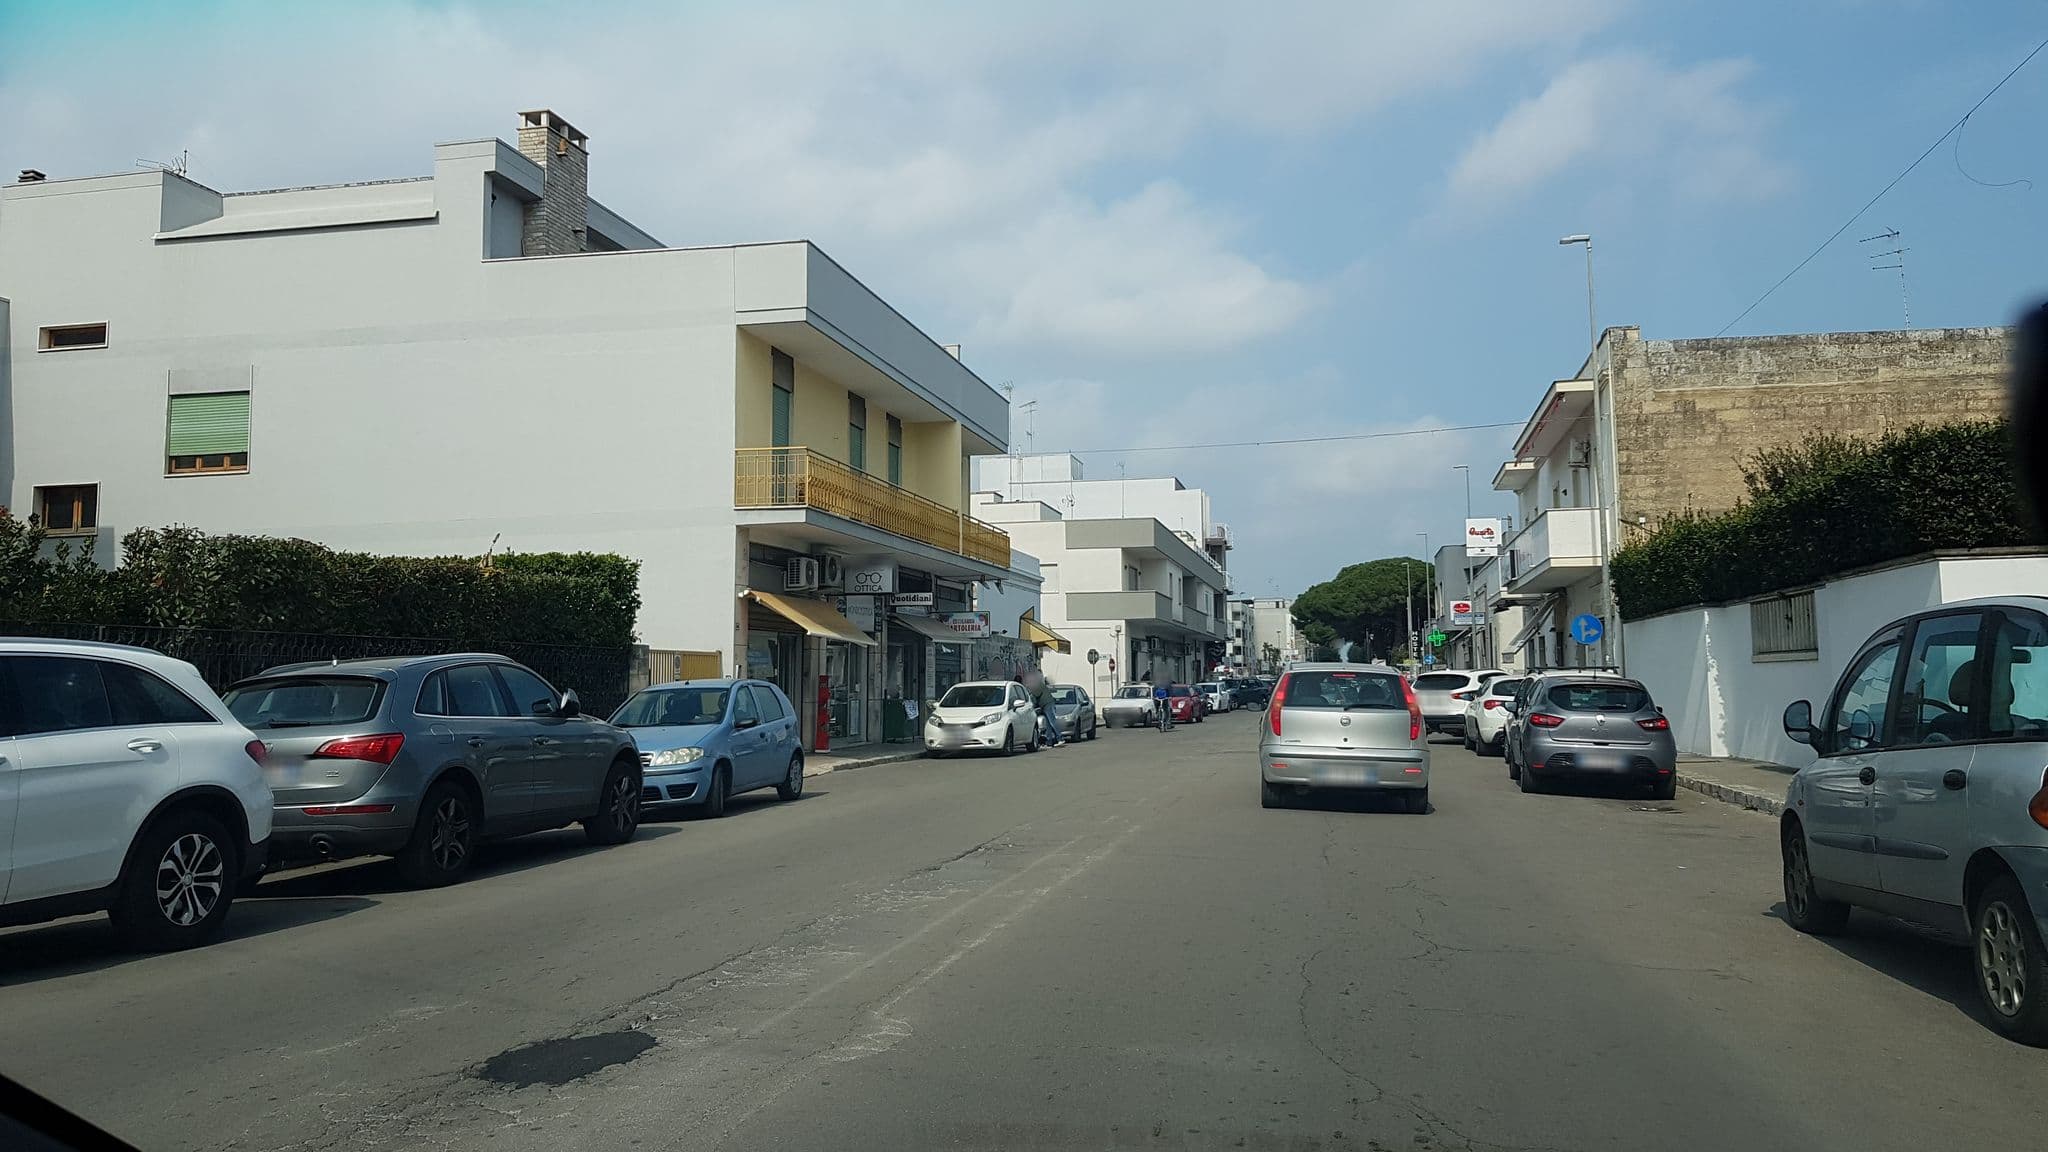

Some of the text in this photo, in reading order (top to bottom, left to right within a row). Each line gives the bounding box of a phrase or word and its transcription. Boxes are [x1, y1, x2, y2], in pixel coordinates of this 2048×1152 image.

[854, 584, 883, 592] OTTICA
[891, 593, 932, 603] Quotidiani
[948, 624, 981, 632] ARTOLERIA
